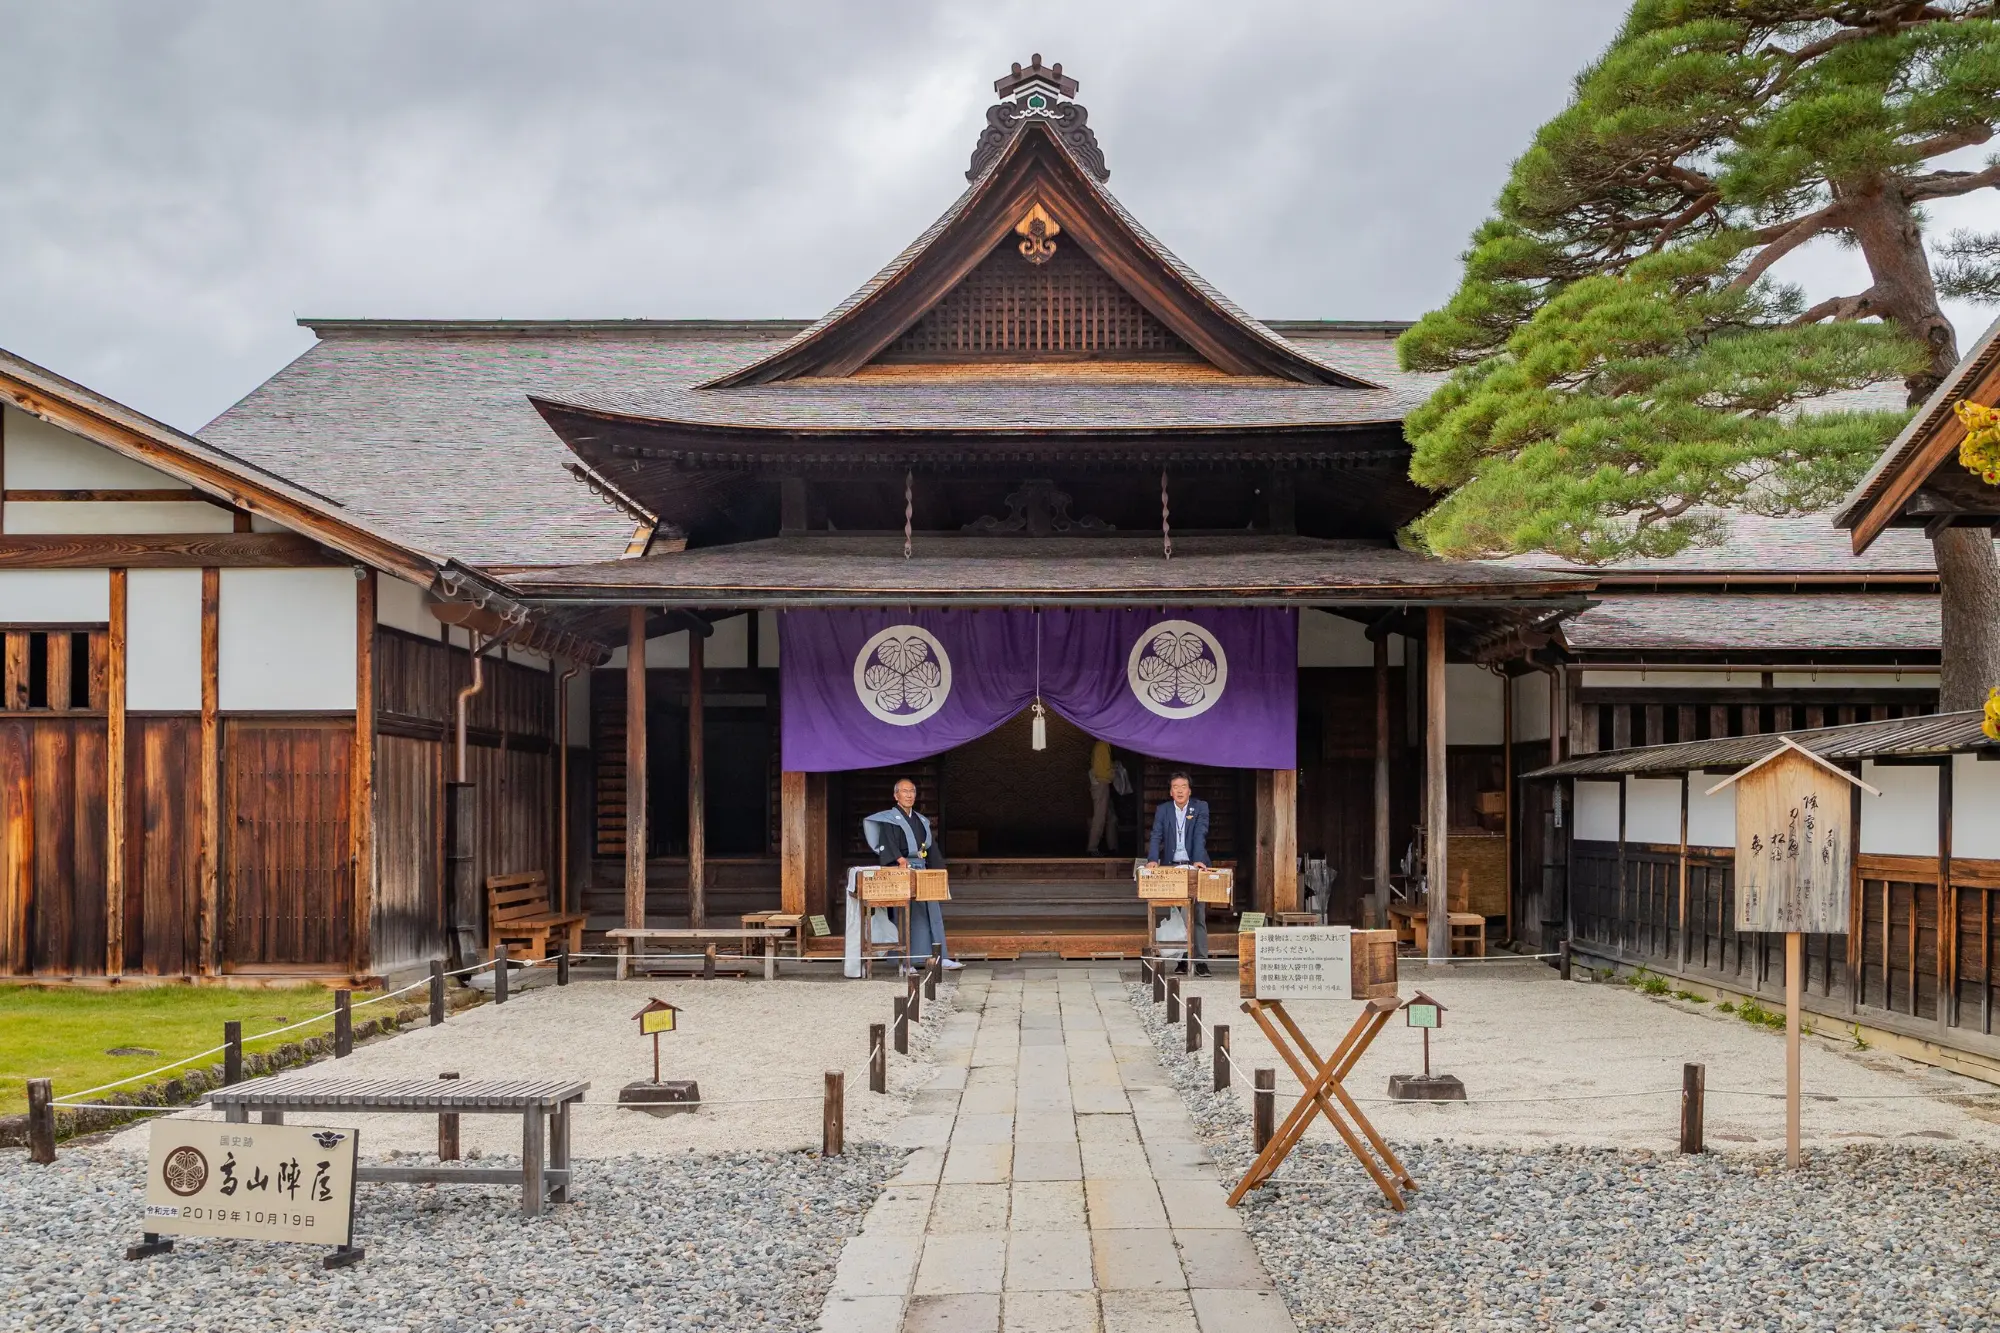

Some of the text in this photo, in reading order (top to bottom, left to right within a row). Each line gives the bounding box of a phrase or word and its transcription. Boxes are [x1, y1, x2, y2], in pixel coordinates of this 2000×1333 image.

[1260, 934, 1346, 942] お履物は、この袋に入れて
[1260, 946, 1315, 954] お持ちください。
[220, 1135, 254, 1148] 国史跡
[220, 1151, 334, 1202] 高山陣屋
[147, 1206, 315, 1227] 令和元年 2019年10月19日
